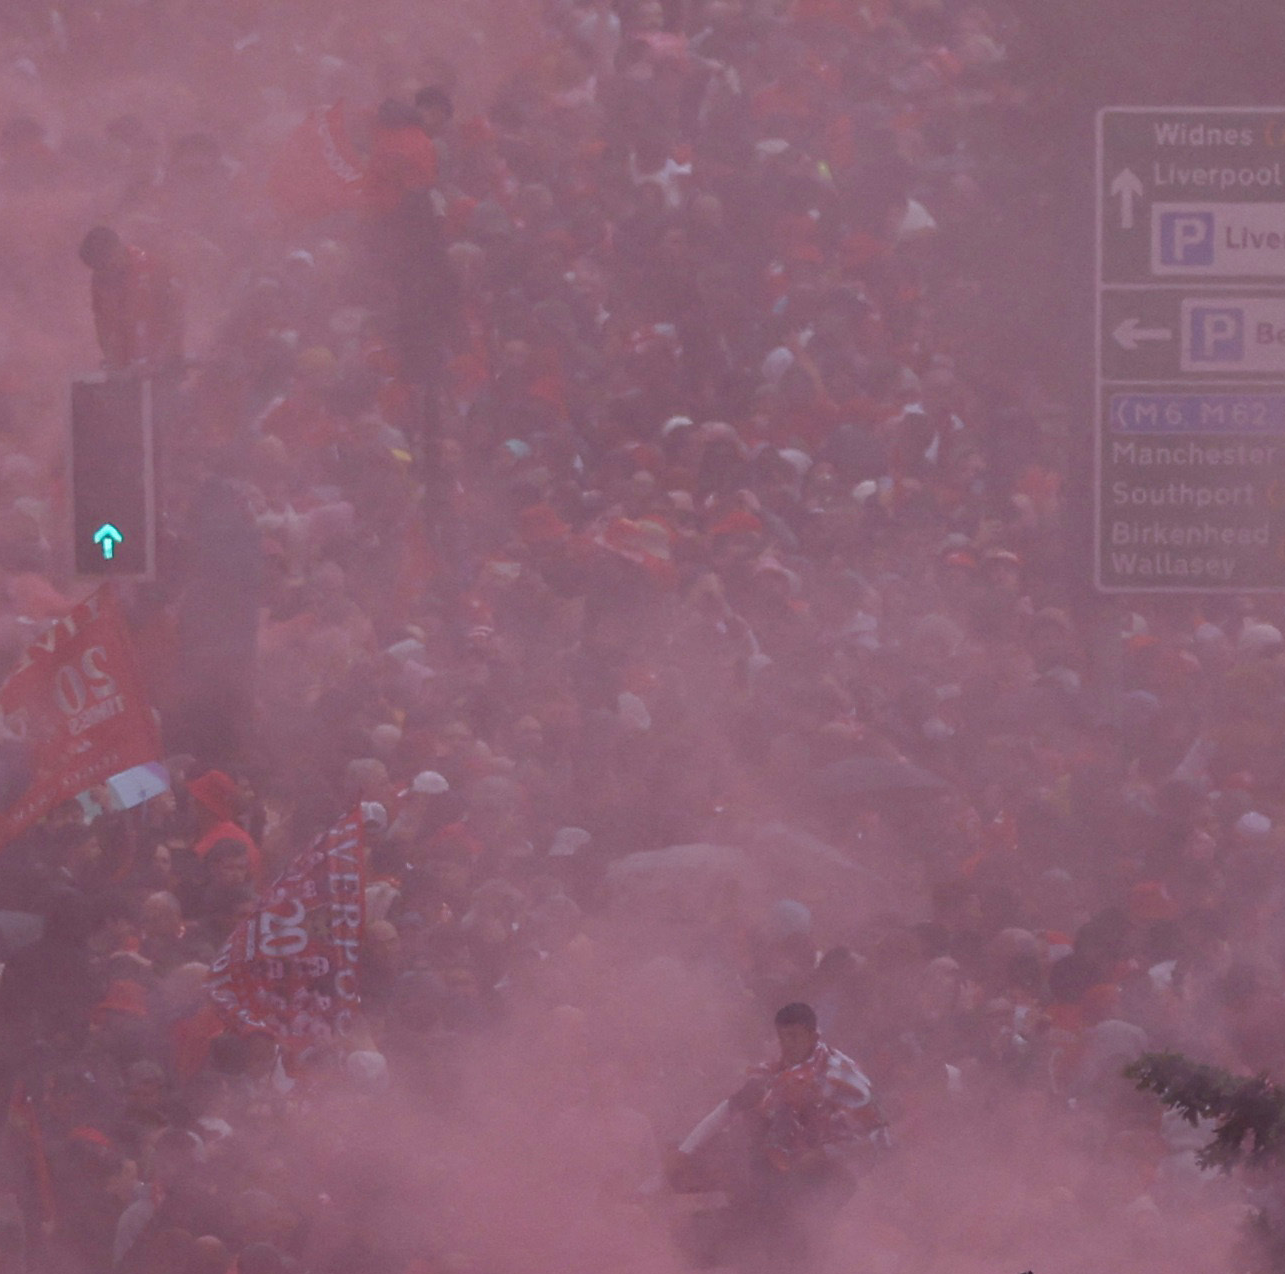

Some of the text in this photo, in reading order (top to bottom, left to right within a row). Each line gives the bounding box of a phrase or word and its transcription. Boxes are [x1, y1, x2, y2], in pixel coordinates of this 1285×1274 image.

[1153, 122, 1253, 147] Widnes
[1154, 162, 1282, 189] Liverpool
[1173, 218, 1208, 262] P
[1112, 442, 1277, 466] Manchester
[1112, 482, 1256, 509] Southport
[1111, 522, 1270, 545] Birkenhead
[1111, 552, 1236, 579] Wallasey
